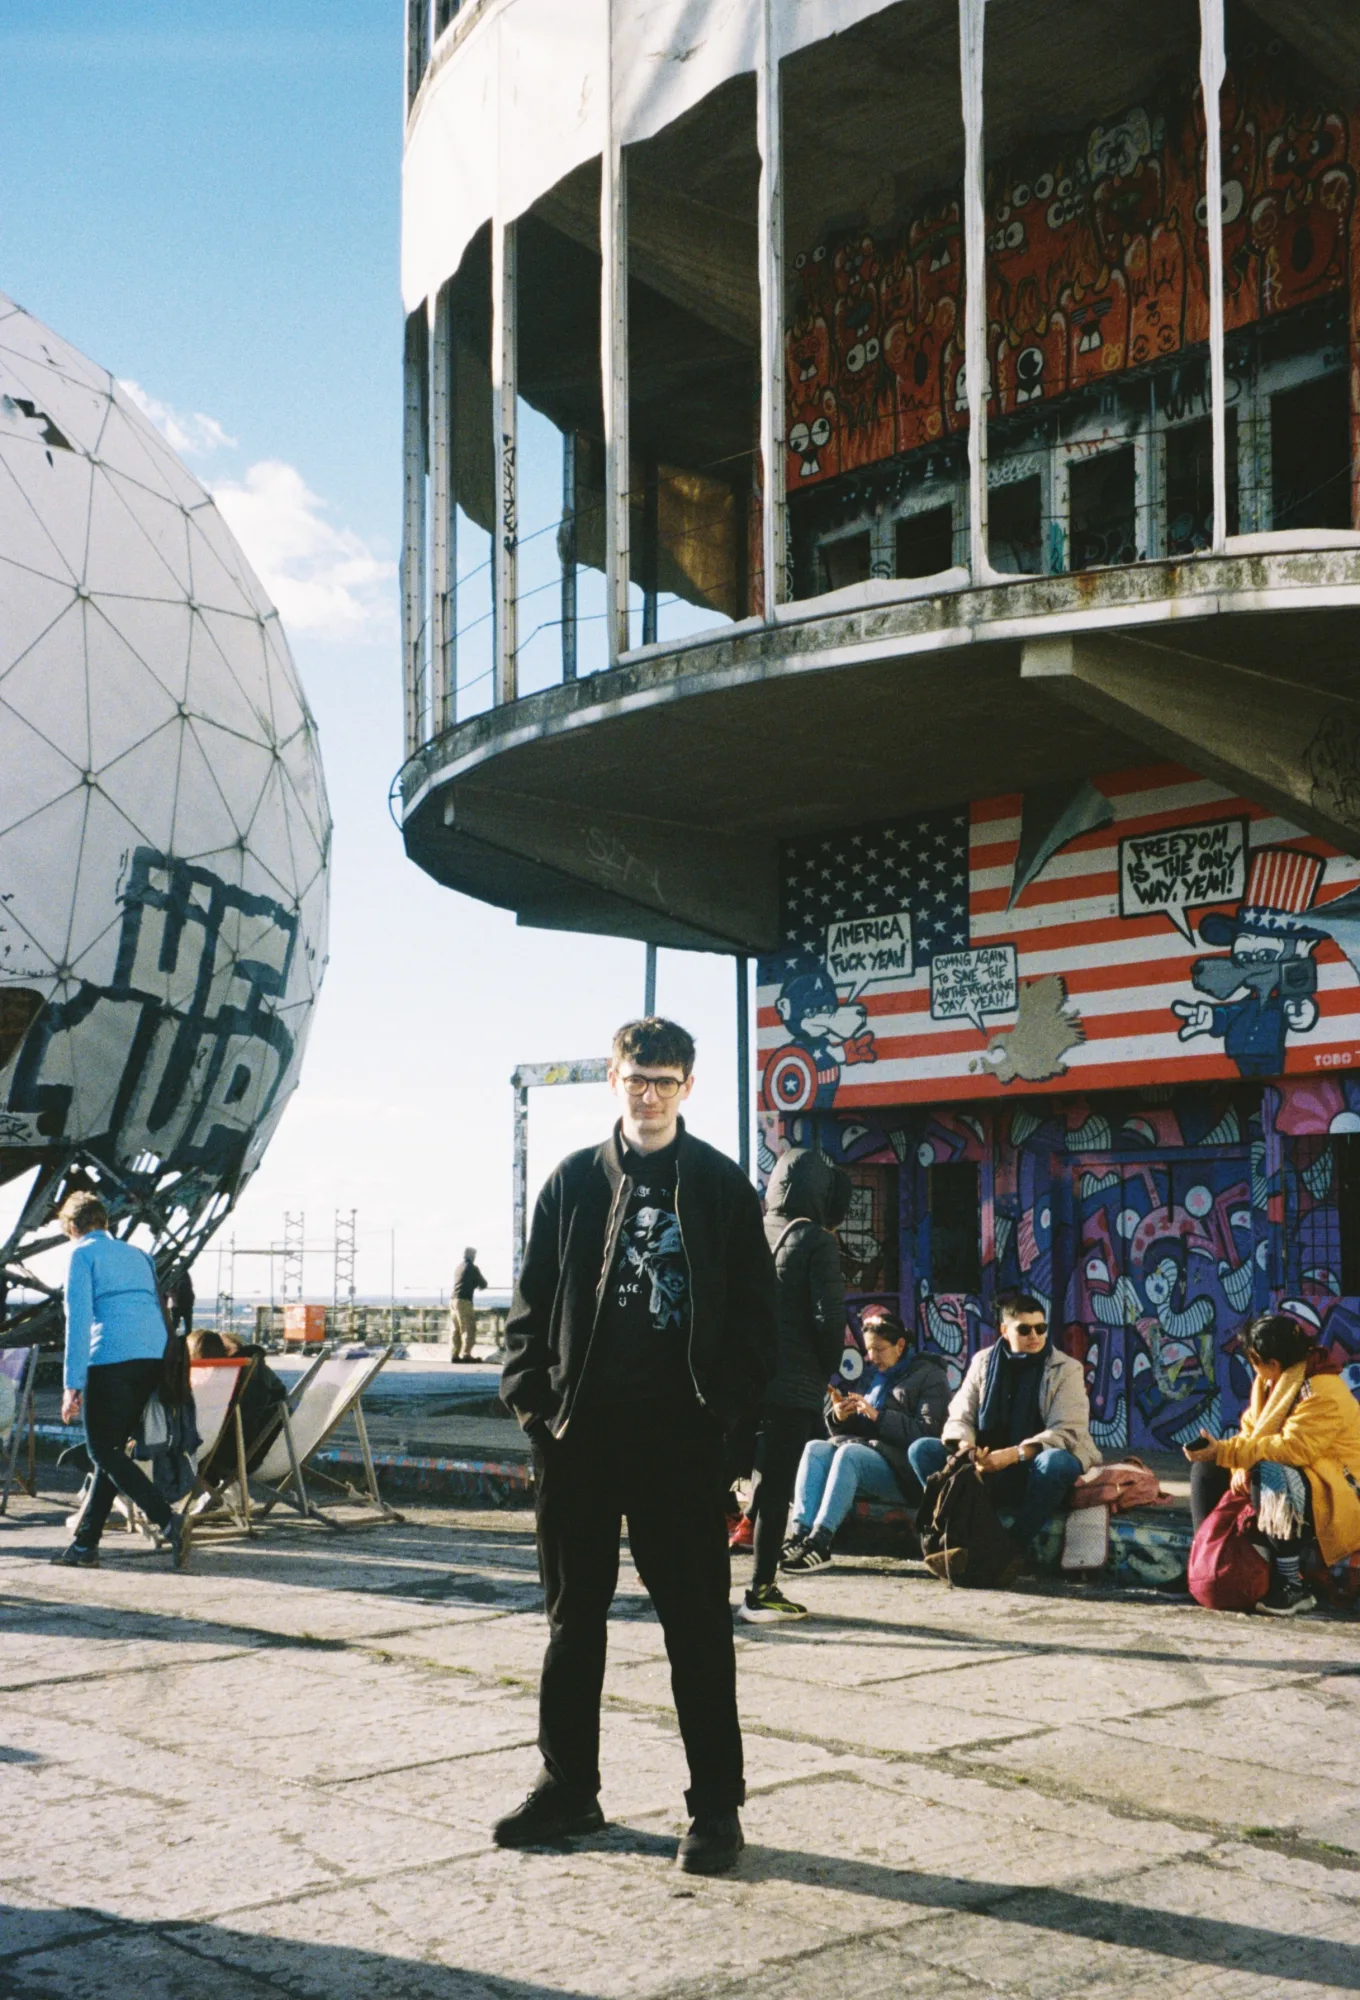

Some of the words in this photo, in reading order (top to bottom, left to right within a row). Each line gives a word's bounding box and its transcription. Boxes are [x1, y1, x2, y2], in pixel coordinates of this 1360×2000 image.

[1129, 826, 1228, 862] FREEDOM
[1127, 861, 1150, 883] IS
[1152, 853, 1193, 877] THE
[1198, 845, 1241, 871] ONLY
[1181, 868, 1234, 901] YEAH!
[830, 953, 866, 976] FUCK
[868, 943, 906, 971] YEAH
[935, 953, 971, 971] COMING
[975, 950, 1008, 969] AGAIN
[933, 973, 949, 985] TO
[952, 968, 979, 984] SAVE
[982, 964, 1008, 979] THE
[934, 979, 1014, 1005] MOTHERFUCKING
[971, 991, 1009, 1011] YEAH!
